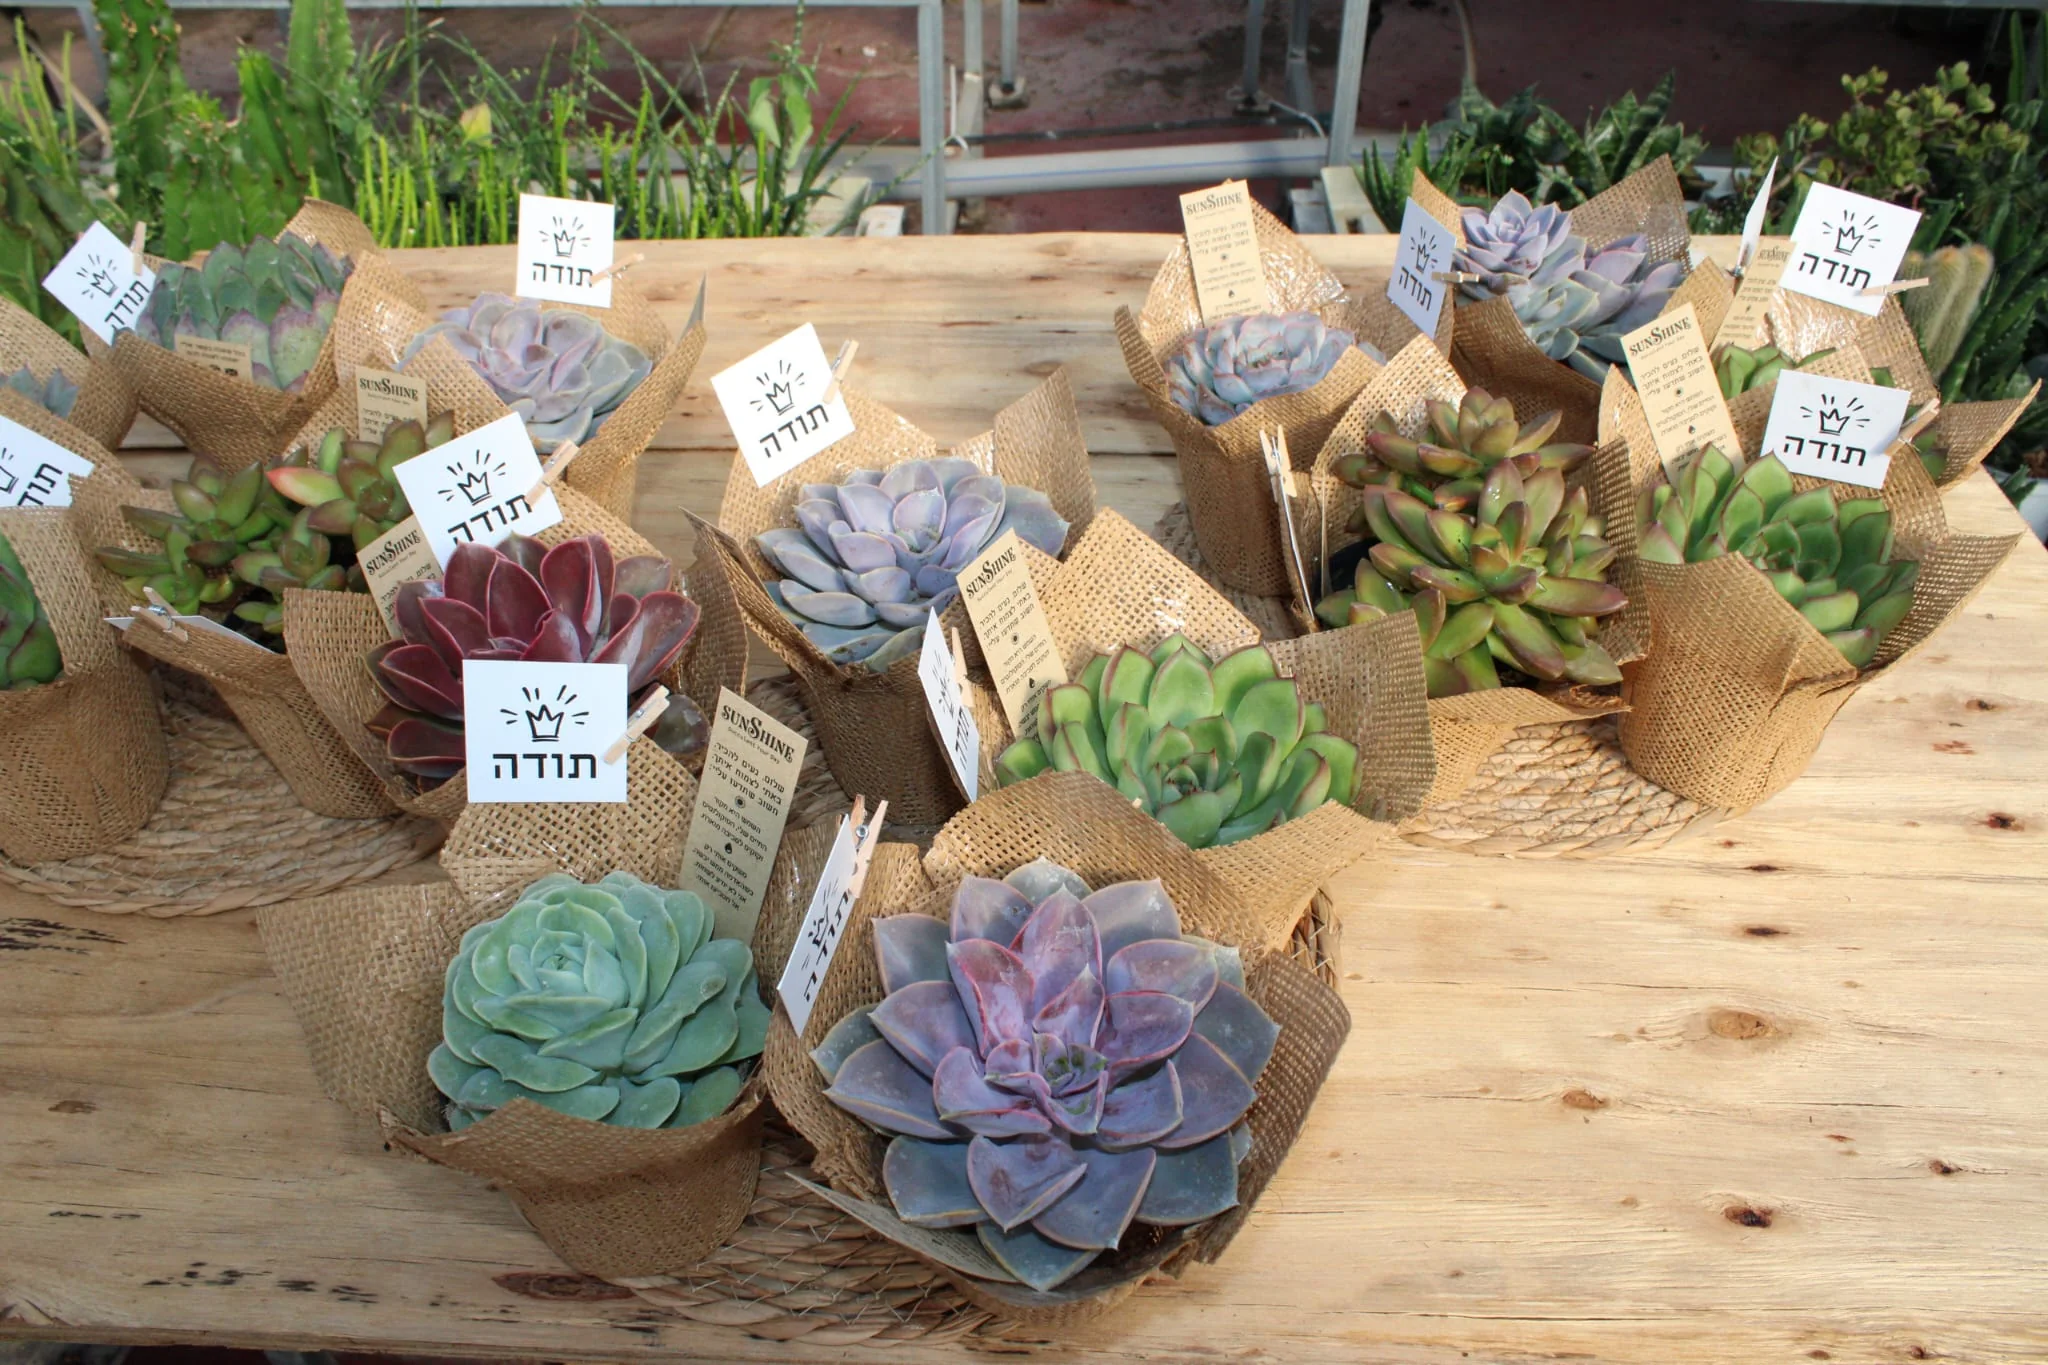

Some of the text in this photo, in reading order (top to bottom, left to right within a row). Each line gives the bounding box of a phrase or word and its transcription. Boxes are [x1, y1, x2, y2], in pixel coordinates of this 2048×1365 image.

[532, 262, 593, 288] תודה
[1399, 266, 1432, 312] תודה
[1799, 253, 1871, 289] תודה
[104, 280, 150, 331] תודה
[1630, 318, 1691, 355] SUNSHINE
[360, 377, 418, 402] SUNSHINE
[759, 404, 829, 458] תודה
[1783, 436, 1867, 466] תודה
[17, 463, 63, 506] תוד
[447, 494, 533, 546] תודה
[365, 530, 421, 576] SUNSHINE
[966, 547, 1016, 597] SUNSHINE
[722, 706, 794, 763] SUNSHINE
[492, 753, 597, 779] תודה
[735, 769, 760, 789] לצמוח
[741, 760, 759, 776] נעים
[758, 798, 779, 817] חשוב
[763, 787, 782, 805] באתי
[803, 889, 849, 1003] תודה
